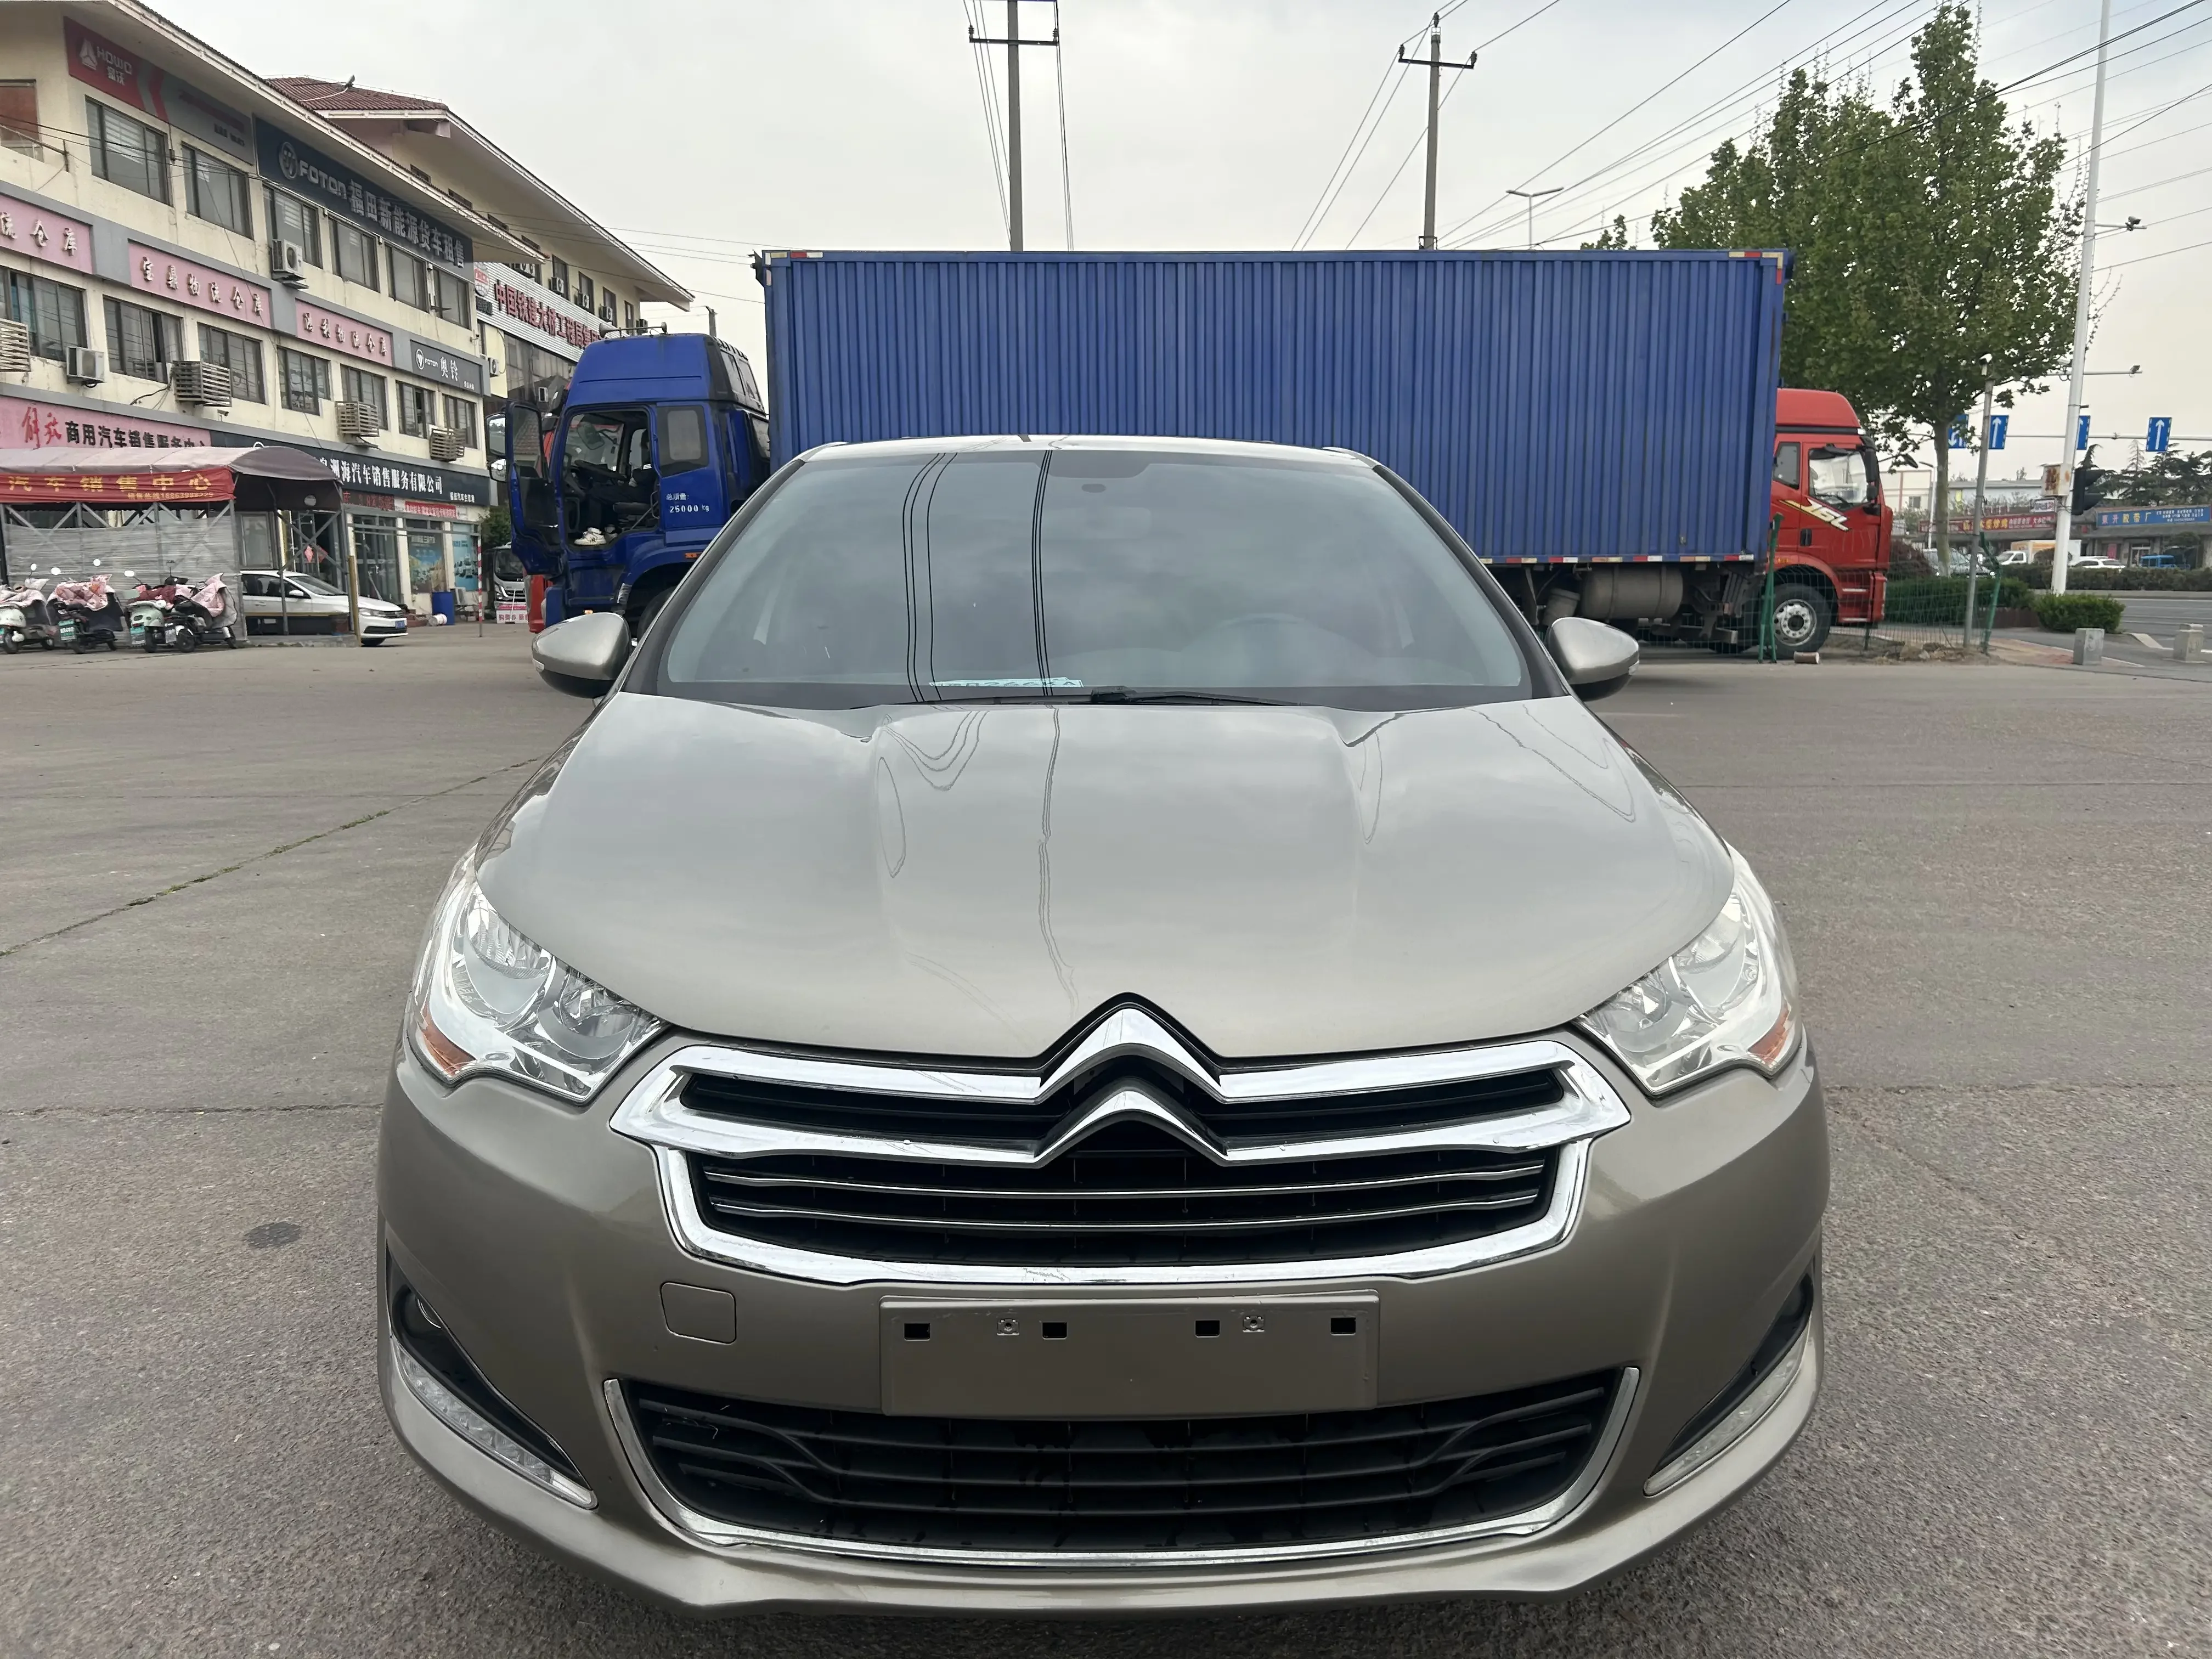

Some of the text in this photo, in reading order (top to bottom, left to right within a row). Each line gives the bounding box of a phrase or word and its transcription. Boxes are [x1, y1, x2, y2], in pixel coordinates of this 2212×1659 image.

[96, 46, 132, 75] HOWO
[299, 160, 347, 200] FOTON
[8, 473, 212, 492] 汽车销售中心
[669, 505, 698, 513] 25000
